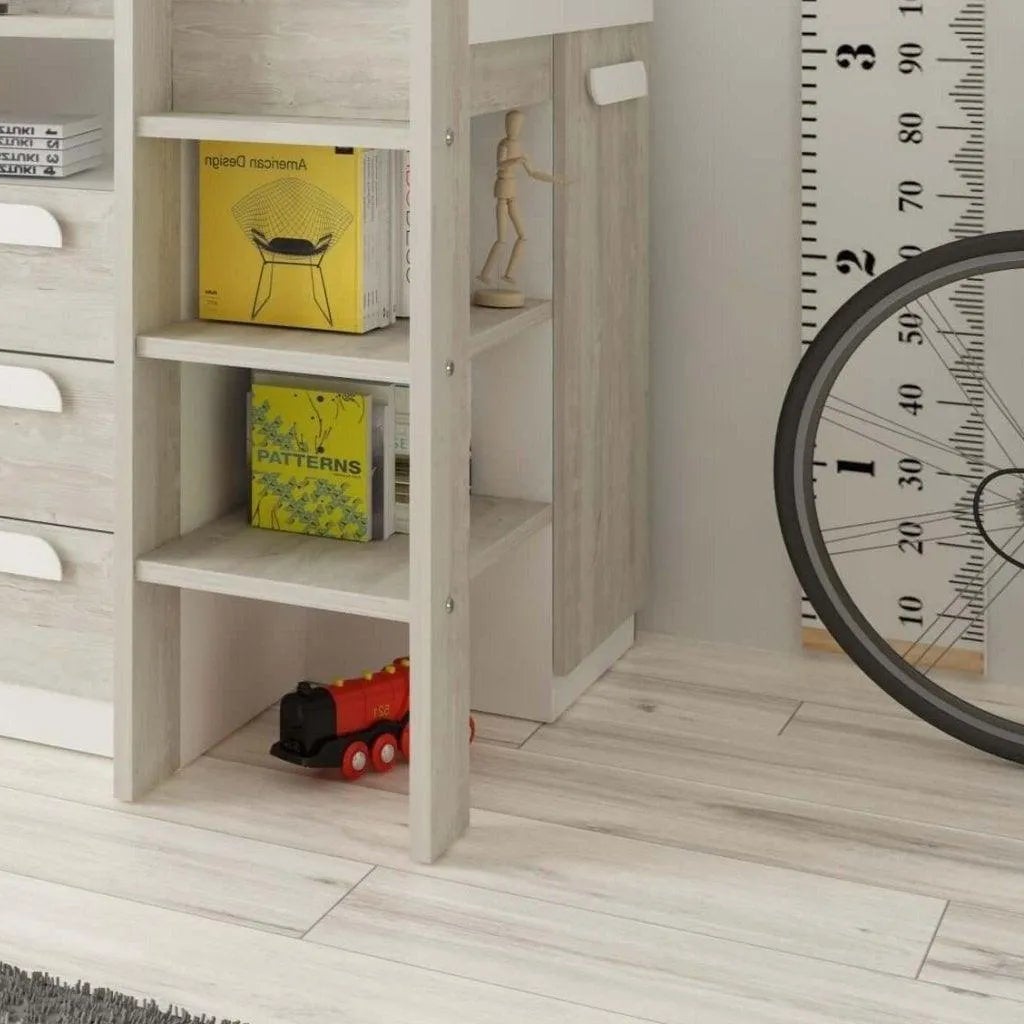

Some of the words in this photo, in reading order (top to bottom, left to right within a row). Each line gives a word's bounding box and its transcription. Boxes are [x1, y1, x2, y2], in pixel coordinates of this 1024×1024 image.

[836, 44, 875, 71] 3
[898, 42, 923, 75] 90
[898, 112, 923, 144] 80
[898, 180, 923, 213] 70
[836, 249, 875, 277] 2
[898, 312, 923, 346] 50
[898, 383, 923, 416] 40
[257, 450, 362, 475] PATTERNS
[836, 460, 875, 477] 1
[898, 457, 923, 491] 30
[898, 521, 923, 555] 20
[898, 595, 923, 628] 10
